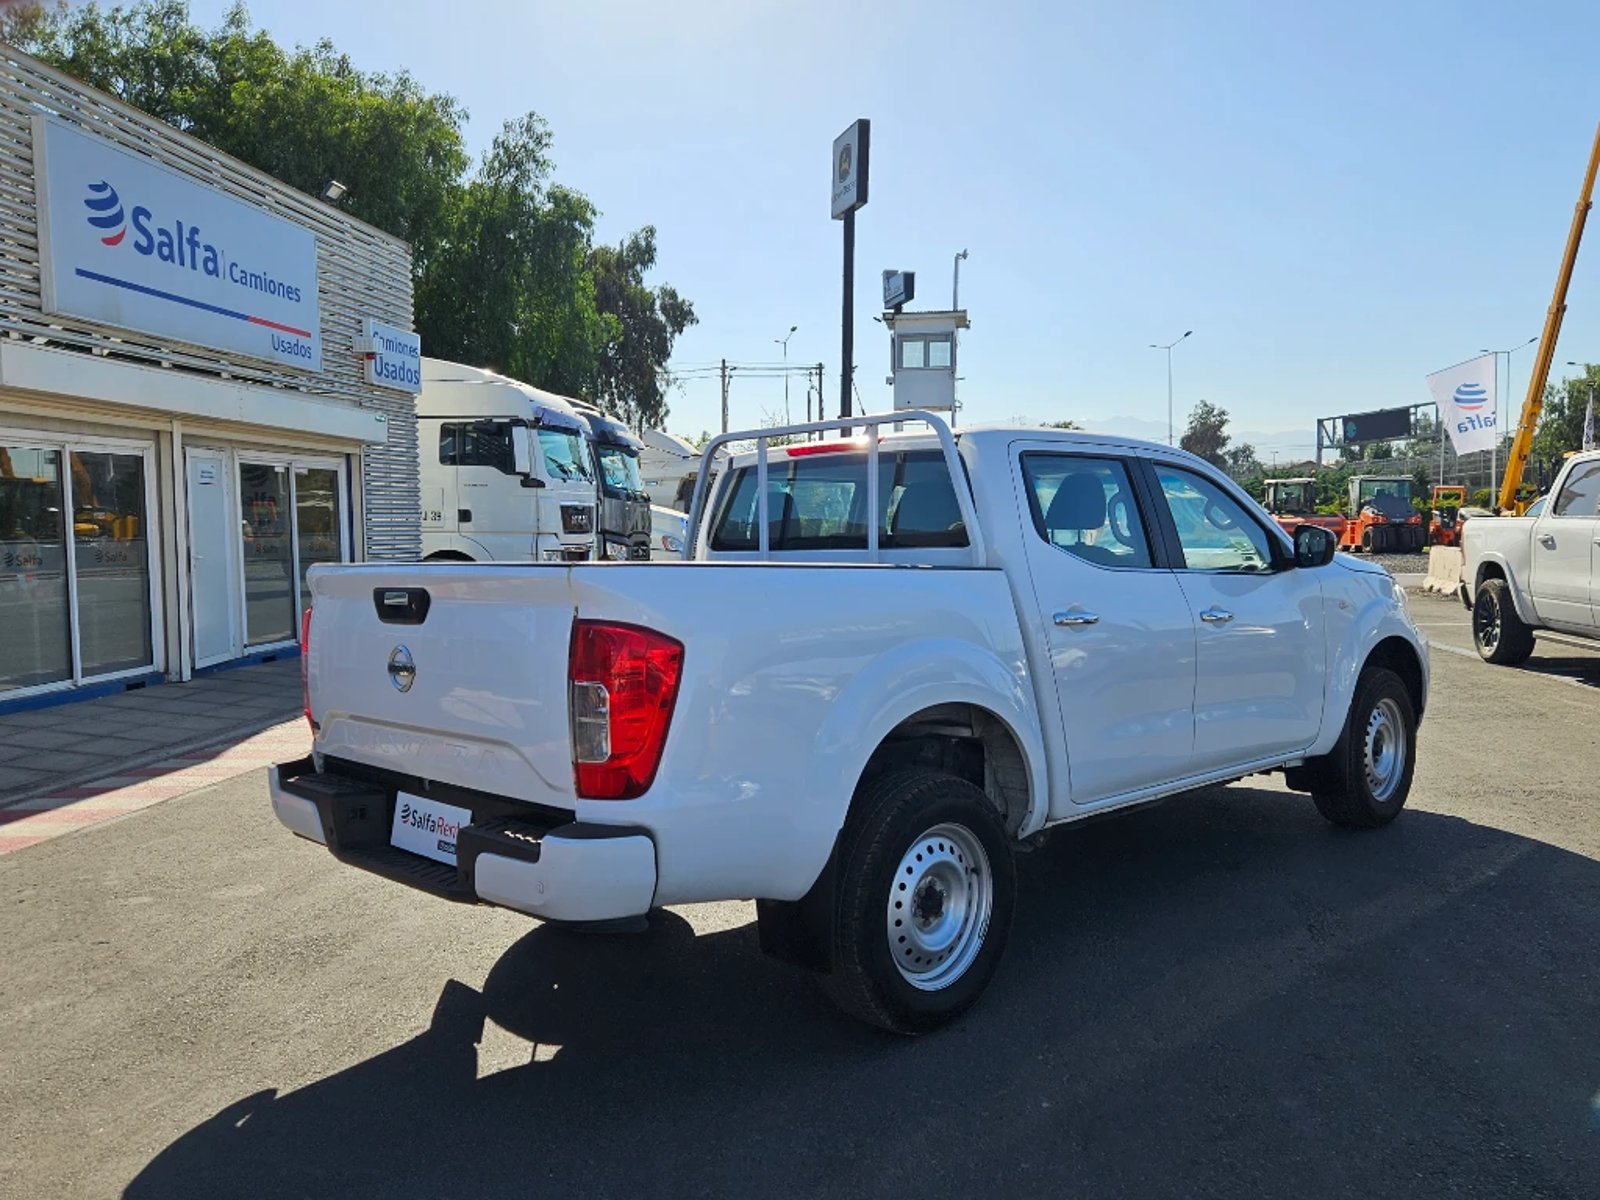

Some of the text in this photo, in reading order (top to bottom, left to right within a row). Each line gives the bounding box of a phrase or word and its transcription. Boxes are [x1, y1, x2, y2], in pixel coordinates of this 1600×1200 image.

[131, 205, 301, 303] Salfa Camiones
[271, 333, 312, 359] Usados
[374, 355, 420, 385] Usados
